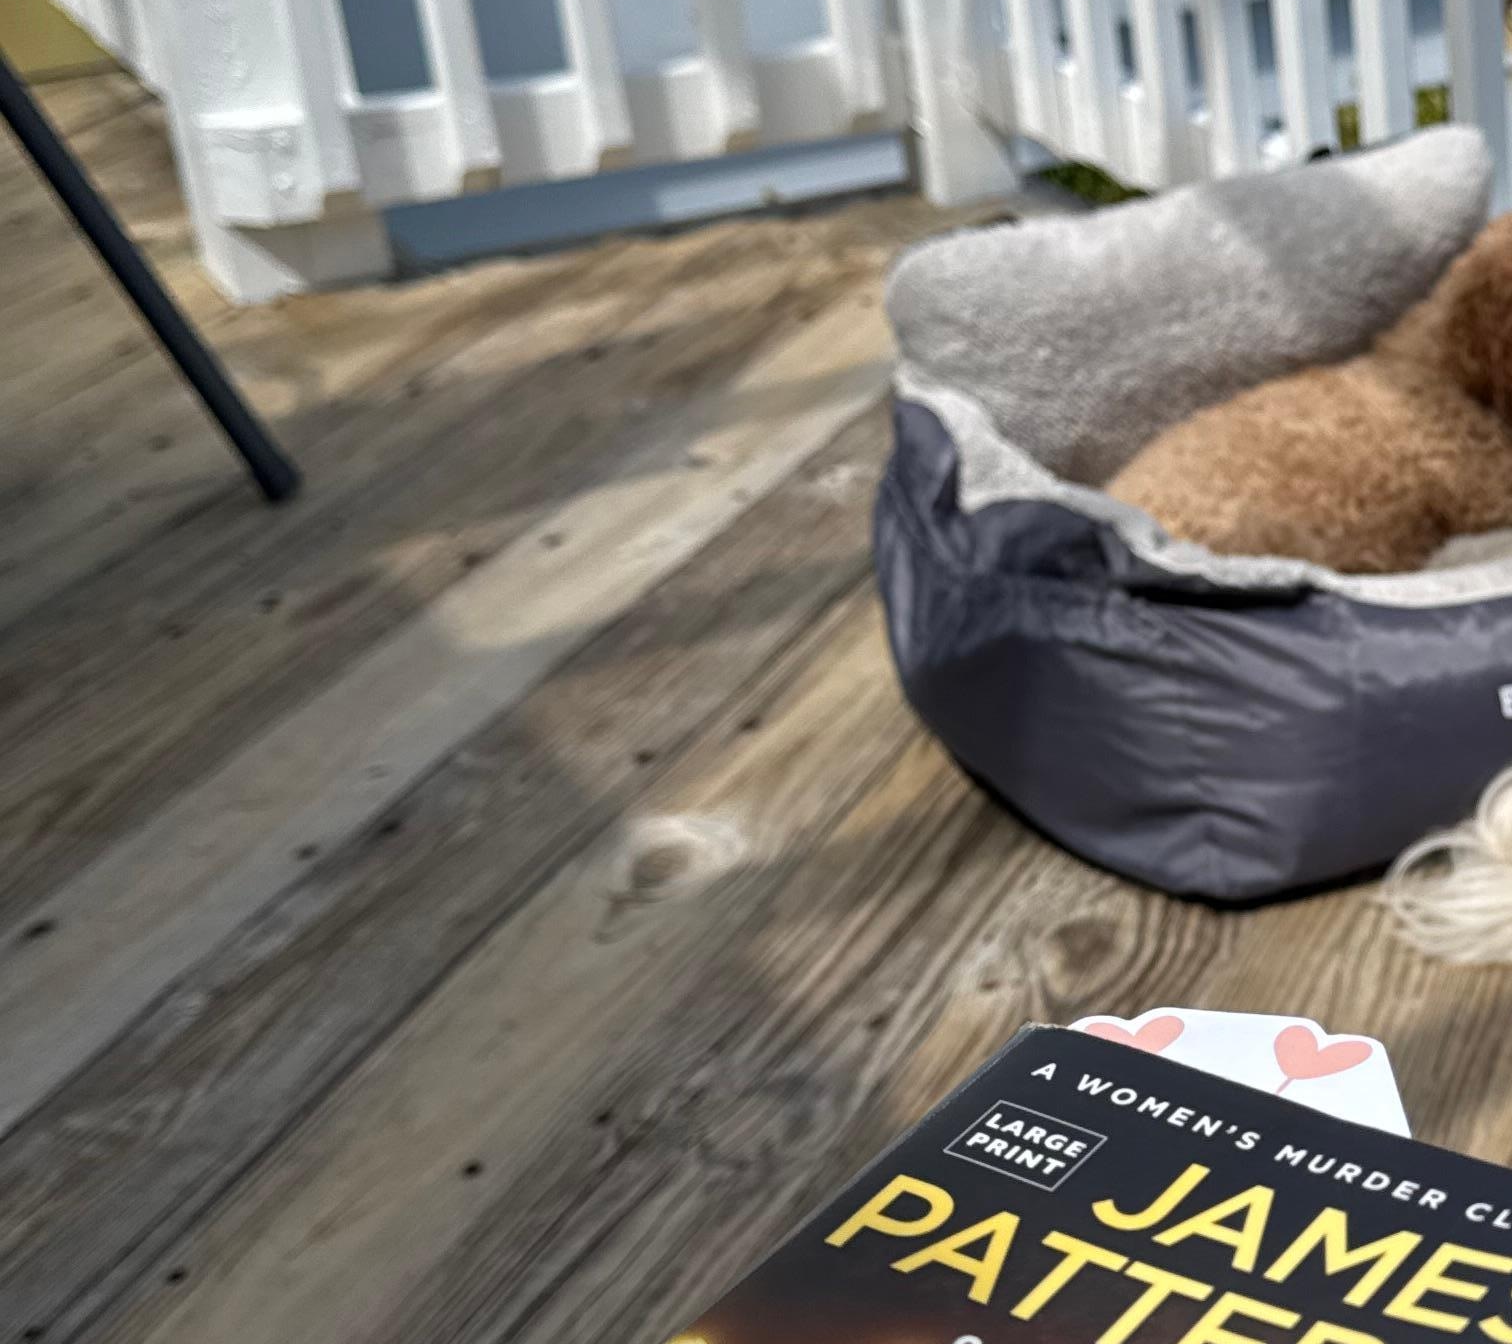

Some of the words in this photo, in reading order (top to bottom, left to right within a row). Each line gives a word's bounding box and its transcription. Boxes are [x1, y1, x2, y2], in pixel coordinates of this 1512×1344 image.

[965, 1131, 1067, 1175] PRINT
[984, 1112, 1088, 1158] LARGE
[1030, 1061, 1058, 1081] A
[1076, 1073, 1261, 1151] WOMEN'S
[1274, 1143, 1450, 1210] MURDER
